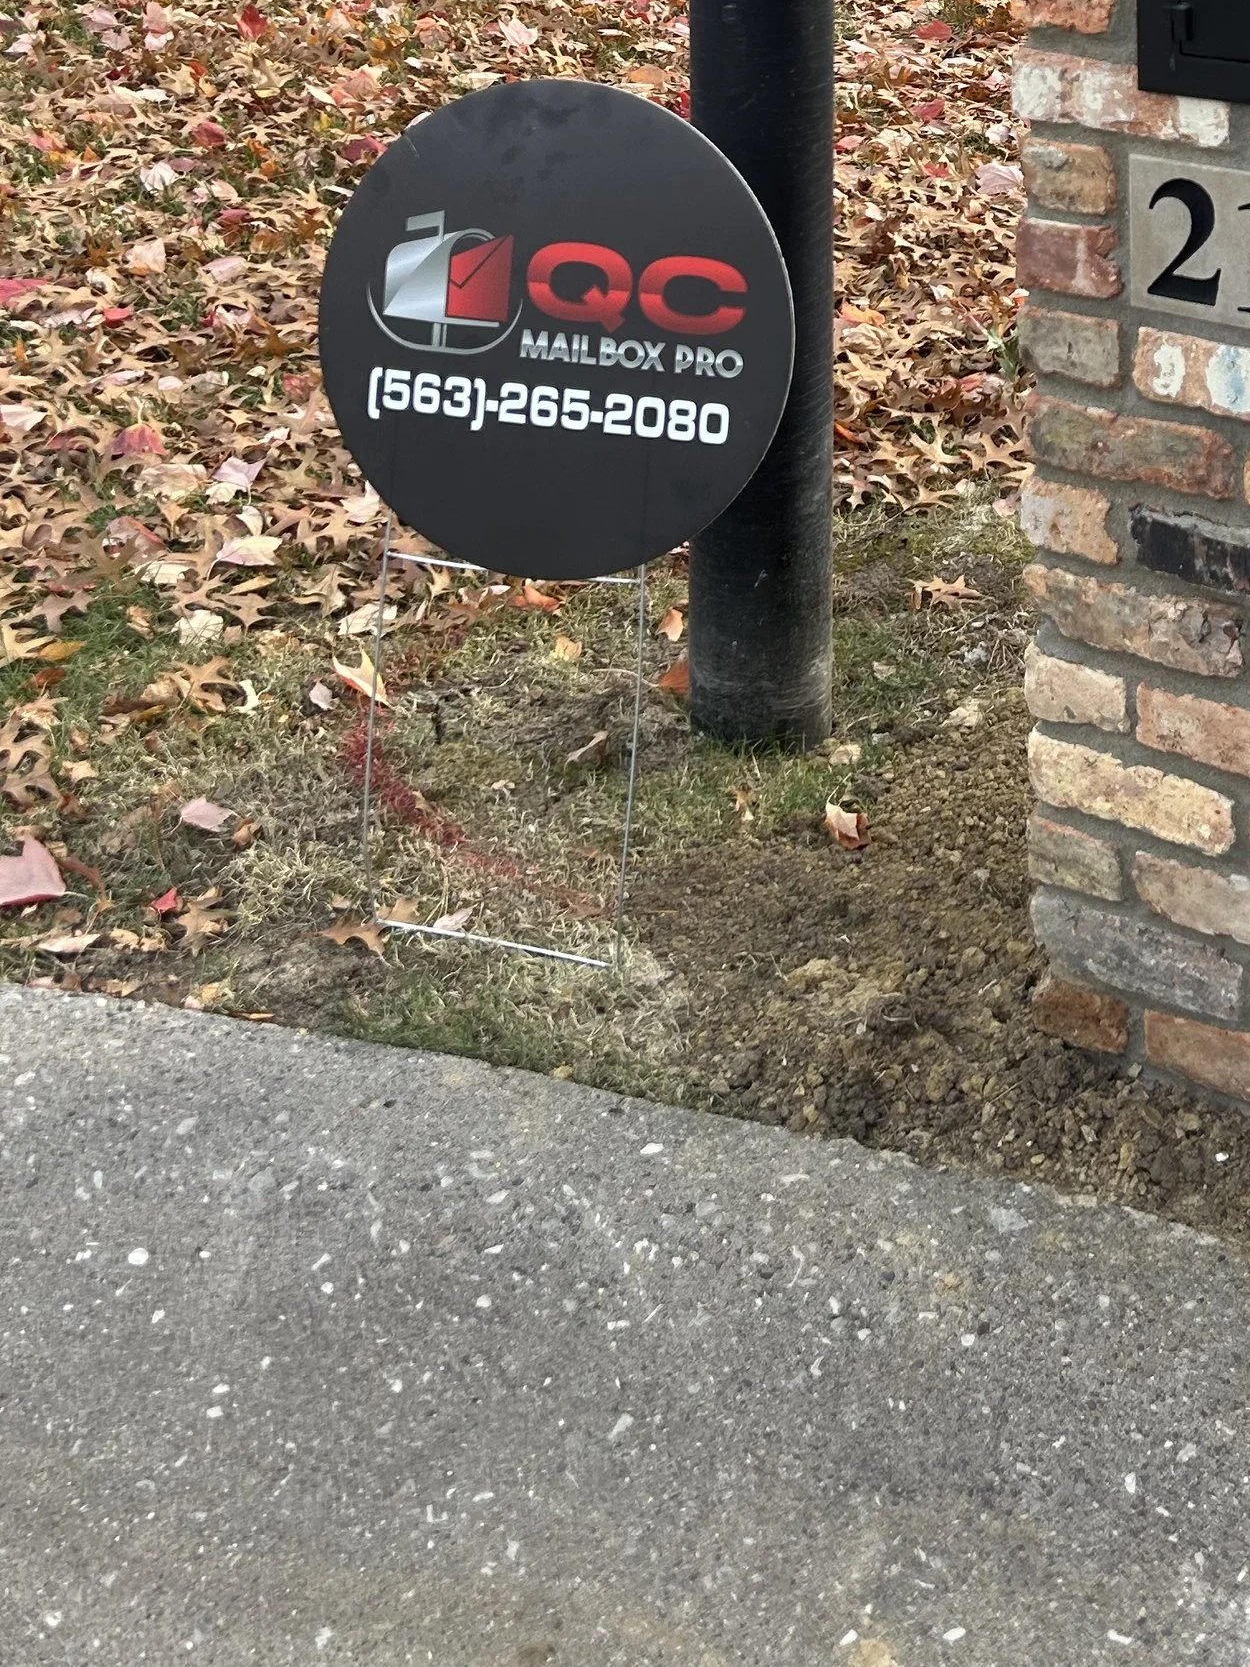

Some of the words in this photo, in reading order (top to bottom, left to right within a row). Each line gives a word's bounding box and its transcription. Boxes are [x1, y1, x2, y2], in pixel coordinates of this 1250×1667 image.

[527, 242, 748, 334] QC
[519, 329, 666, 373] MAILBOX
[674, 343, 744, 379] PRO
[367, 367, 730, 444] (563)-265-2080
